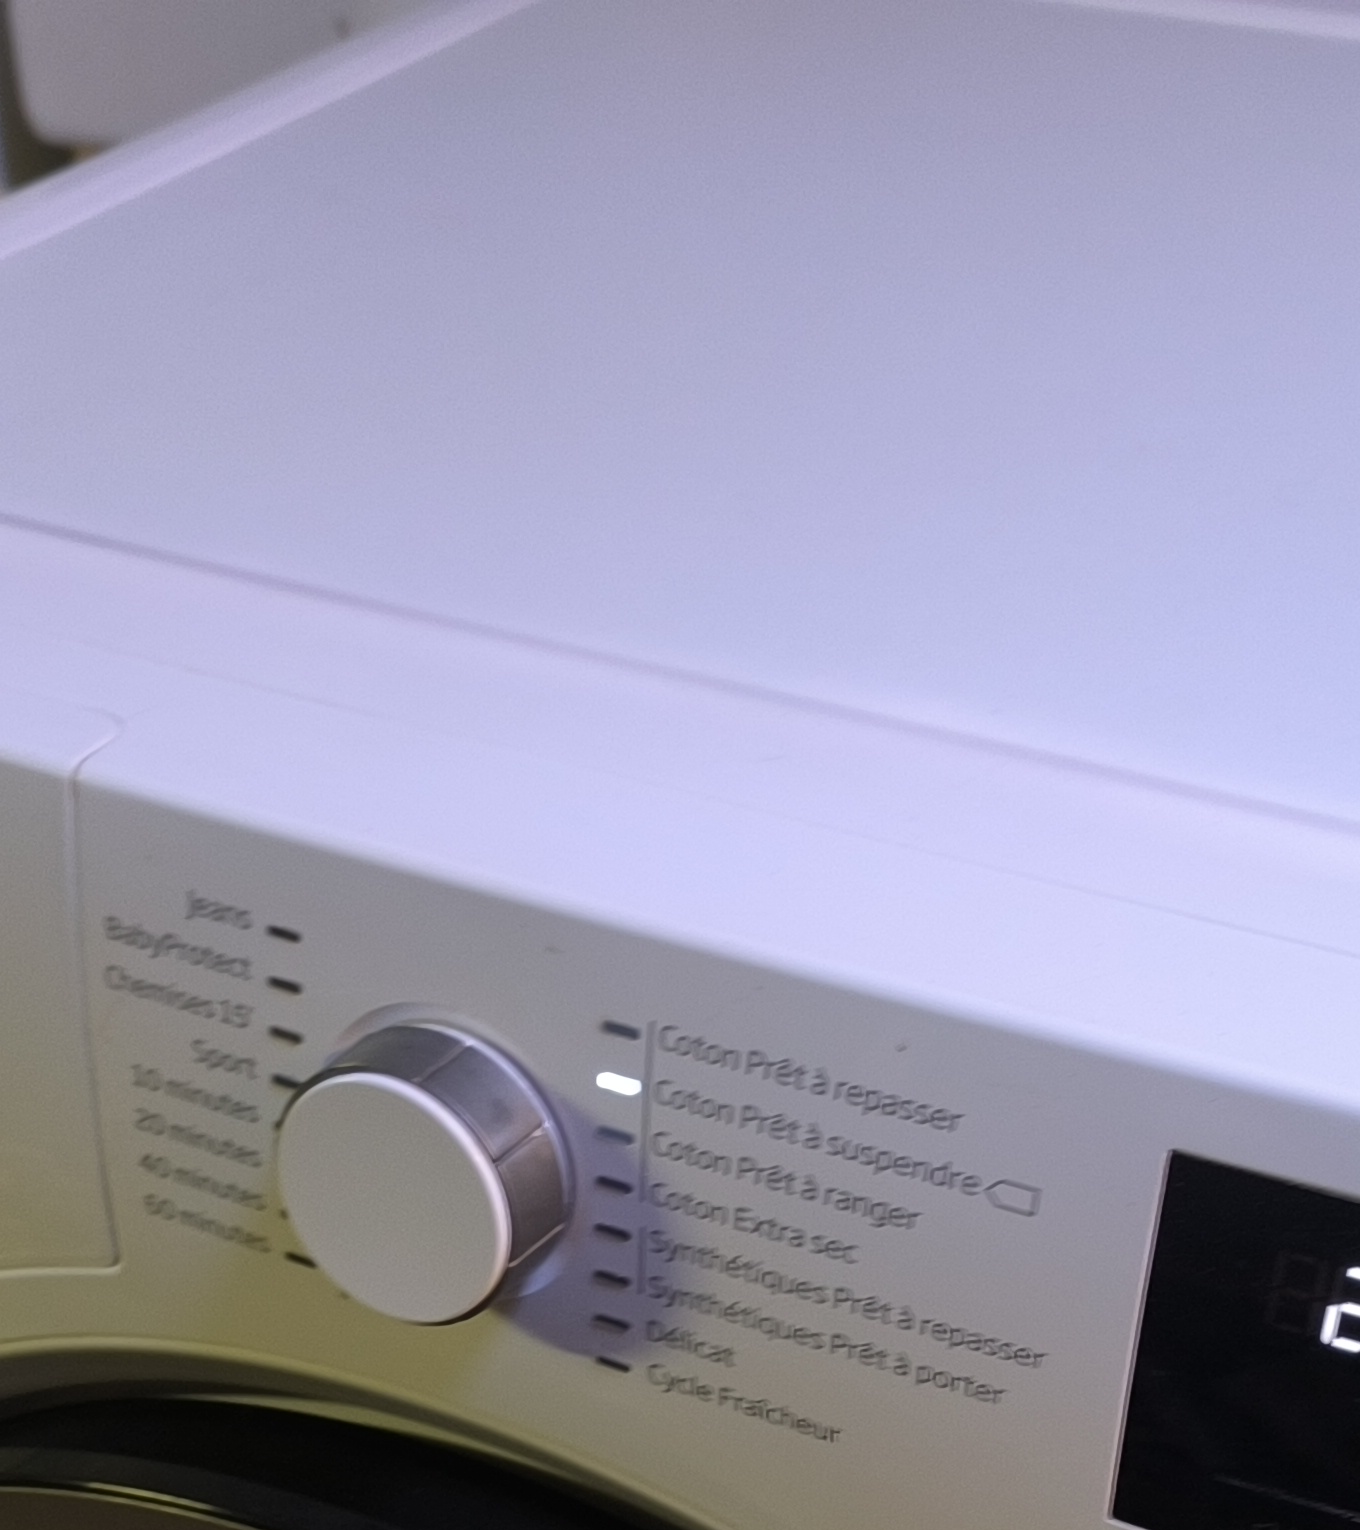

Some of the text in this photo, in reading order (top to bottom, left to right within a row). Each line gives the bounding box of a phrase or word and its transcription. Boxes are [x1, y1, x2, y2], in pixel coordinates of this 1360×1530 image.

[658, 1024, 967, 1133] Coton Prêt à repasser
[652, 1130, 924, 1230] Coton Prêt à ranger
[653, 1078, 984, 1197] Coton Prêt à suspendre
[650, 1182, 860, 1265] Coton Extra sec
[645, 1319, 737, 1368] Délicat
[646, 1275, 1009, 1405] Synthétiques Prêt à porter
[648, 1229, 1050, 1368] Synthétiques Prêt à repasser
[647, 1363, 844, 1443] Cycle Fraîcheur
